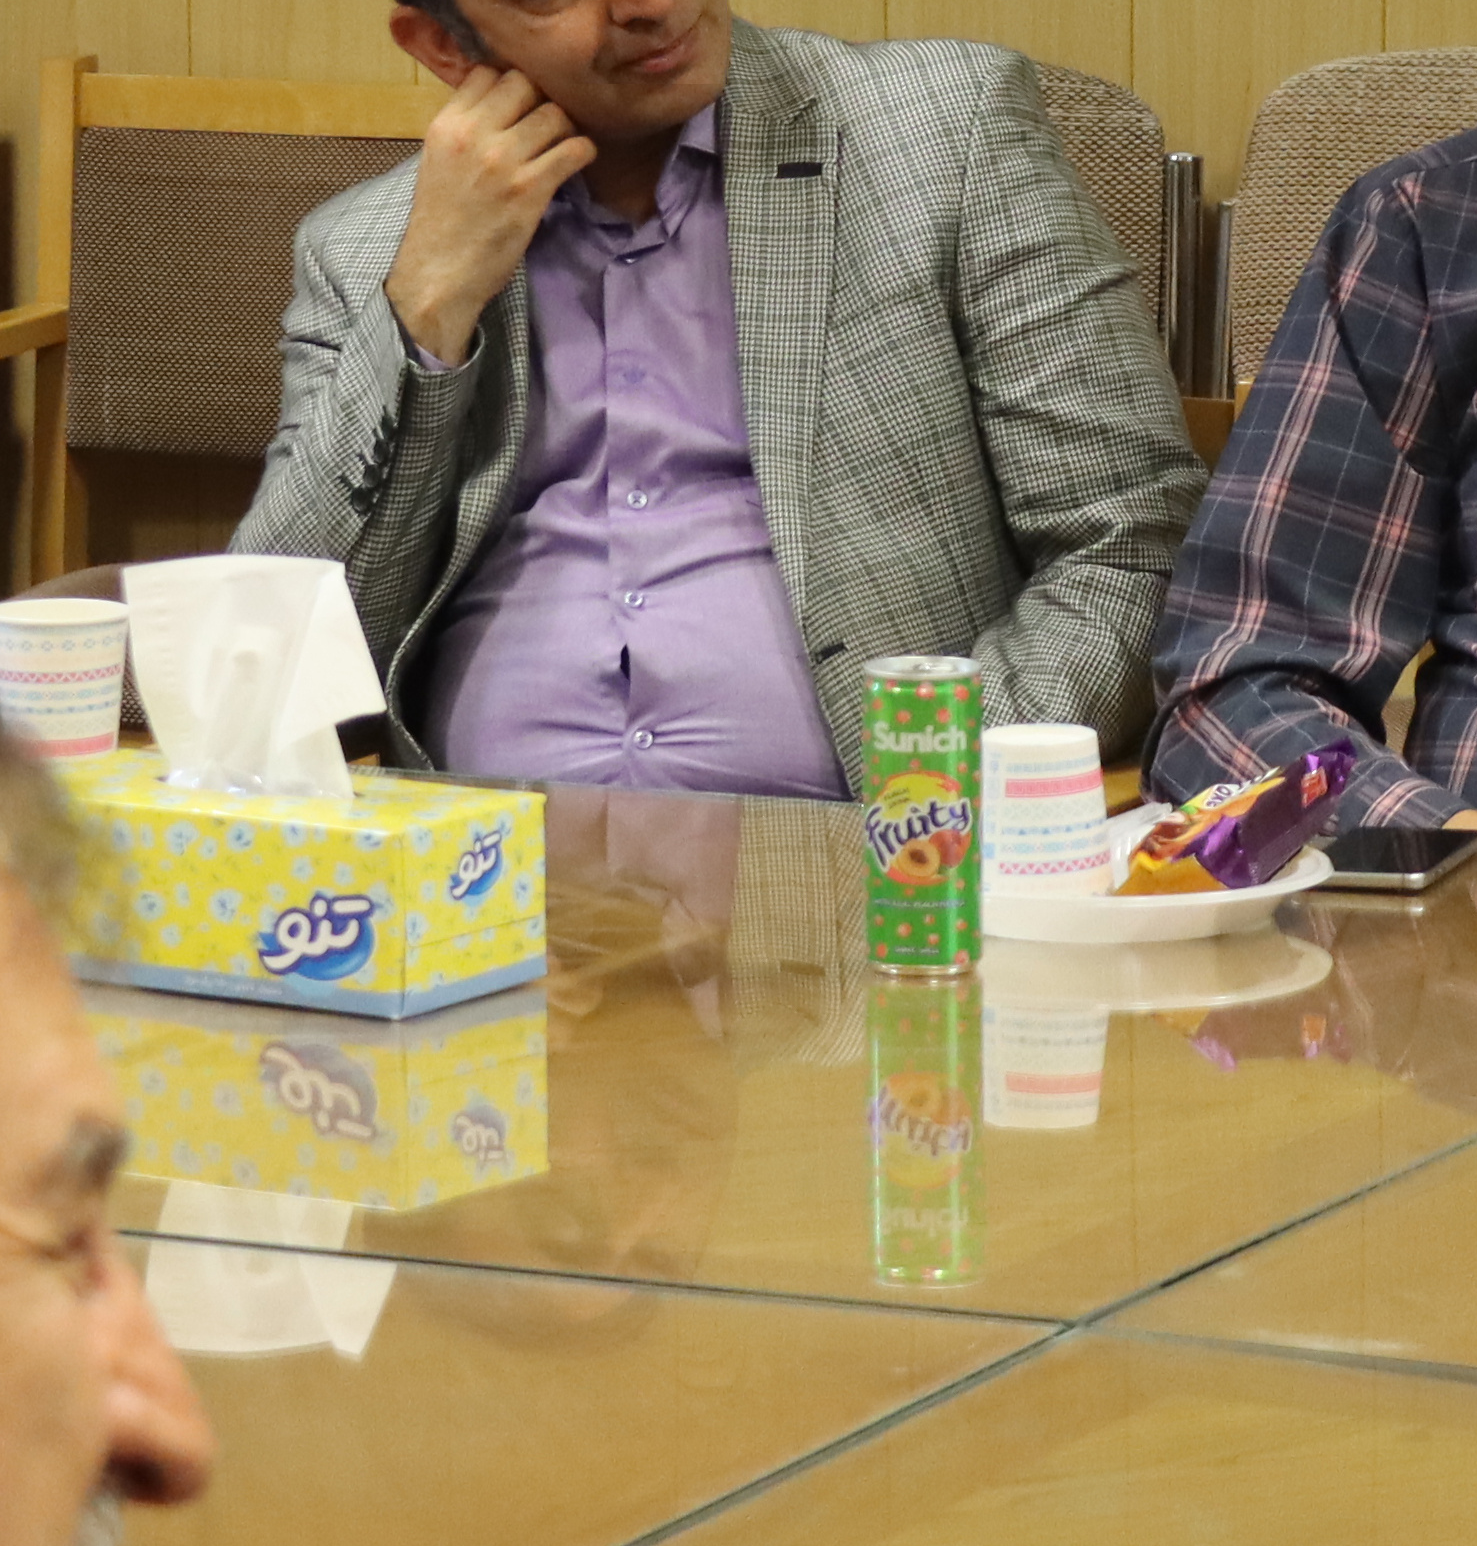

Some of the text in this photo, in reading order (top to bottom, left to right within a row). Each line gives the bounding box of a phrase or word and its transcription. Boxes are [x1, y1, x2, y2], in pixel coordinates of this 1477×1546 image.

[873, 720, 968, 754] Sunich
[449, 831, 502, 900] تنو
[865, 799, 970, 868] Fruity
[258, 895, 373, 973] تنو
